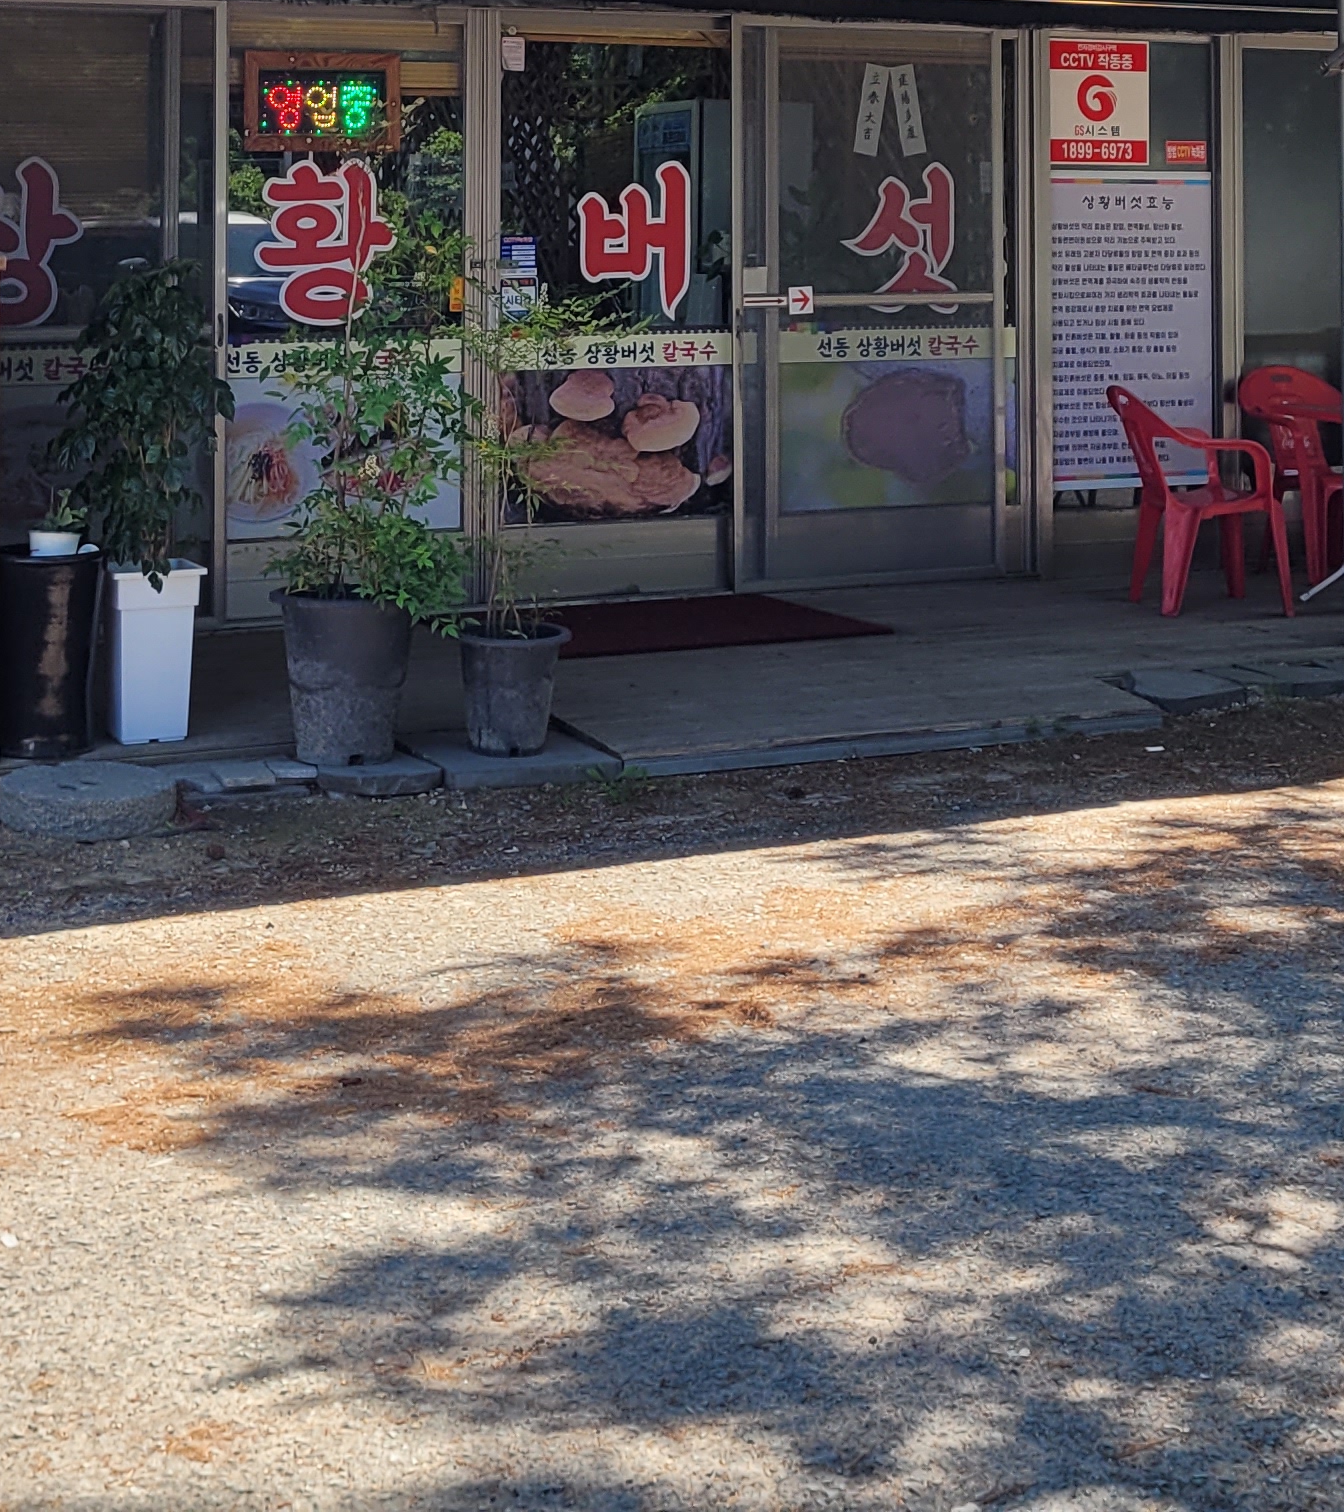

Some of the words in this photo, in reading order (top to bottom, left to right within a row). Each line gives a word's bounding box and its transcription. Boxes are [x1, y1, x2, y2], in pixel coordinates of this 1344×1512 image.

[1060, 53, 1094, 68] CCTV
[1098, 53, 1134, 70] 작동중
[267, 85, 372, 129] 영업중
[1074, 125, 1121, 137] GS시스템
[1061, 141, 1133, 160] 1899-6973
[1082, 195, 1175, 210] 상황버섯효능
[256, 159, 397, 325] 황
[578, 161, 691, 320] 버
[841, 162, 959, 313] 섯
[584, 341, 656, 365] 상황버섯
[662, 340, 719, 363] 칼국수
[817, 337, 850, 358] 선동
[856, 335, 922, 357] 상황버섯
[928, 335, 980, 355] 칼국수
[227, 349, 262, 374] 선동
